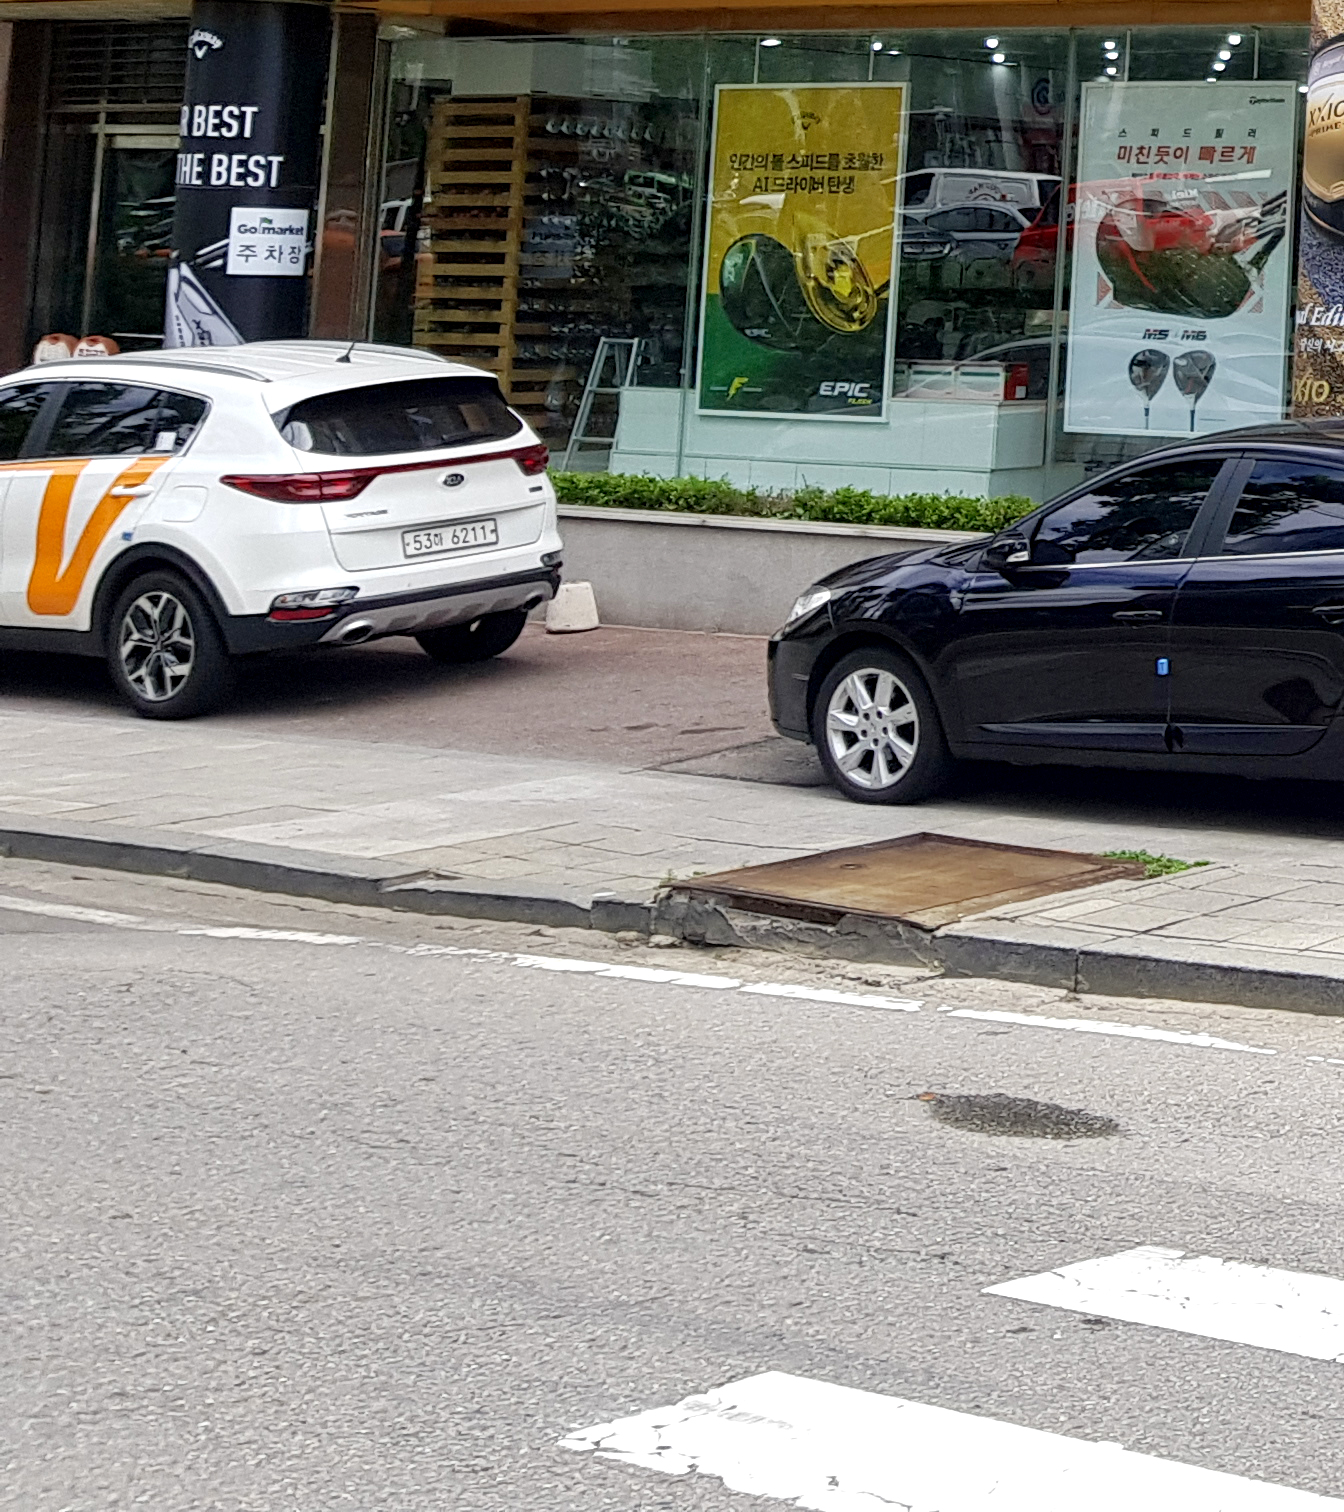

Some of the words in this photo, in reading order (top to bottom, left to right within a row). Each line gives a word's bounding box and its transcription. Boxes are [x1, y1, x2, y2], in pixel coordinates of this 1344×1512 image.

[192, 105, 259, 138] BEST
[729, 153, 769, 170] 인간의
[1117, 145, 1190, 165] 미친듯이
[1198, 145, 1257, 165] 빠르게
[210, 154, 284, 187] BEST
[752, 177, 769, 192] AI
[769, 176, 825, 194] 드라이버
[828, 175, 855, 194] 탄생
[819, 381, 871, 397] EPIC
[452, 525, 488, 546] 6211
